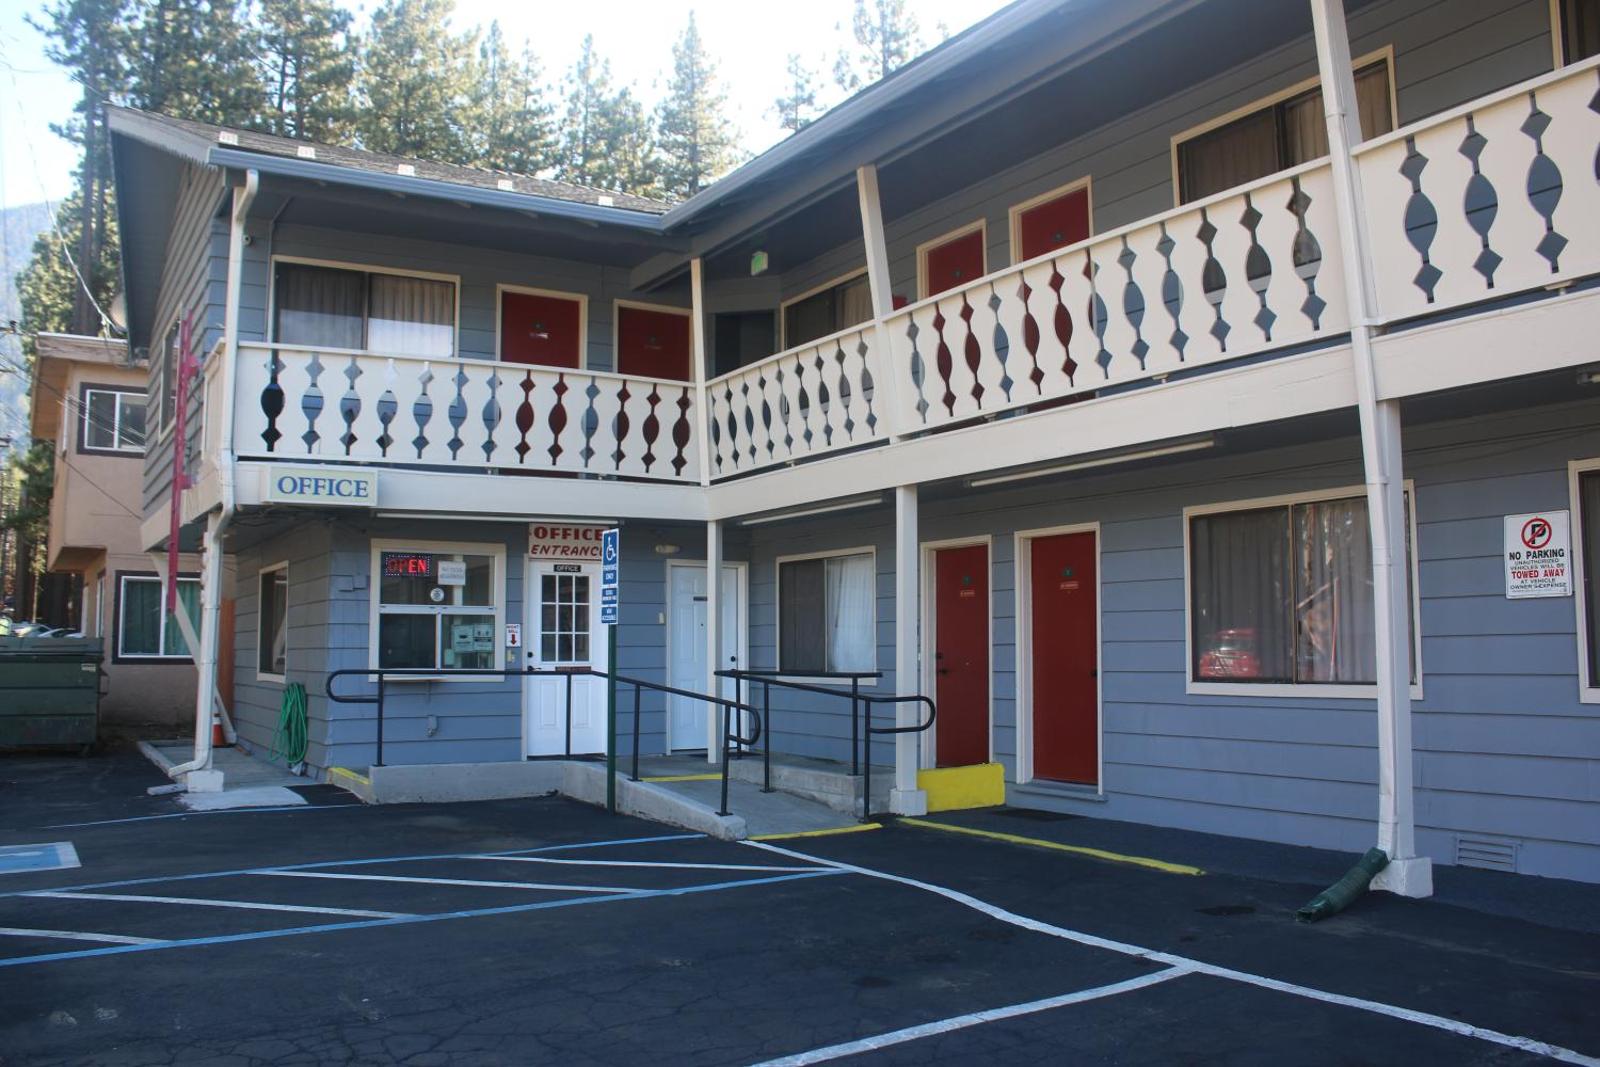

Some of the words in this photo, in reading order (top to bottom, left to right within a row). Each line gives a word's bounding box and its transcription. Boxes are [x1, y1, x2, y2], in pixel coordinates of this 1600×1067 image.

[277, 475, 369, 498] OFFICE
[534, 526, 603, 540] OFFICE
[530, 544, 603, 557] ENTRANC
[1509, 552, 1521, 560] NO
[1526, 548, 1565, 560] PARKING
[387, 558, 428, 573] OPEN
[1512, 570, 1539, 579] TOWED
[1543, 568, 1564, 578] AWAY
